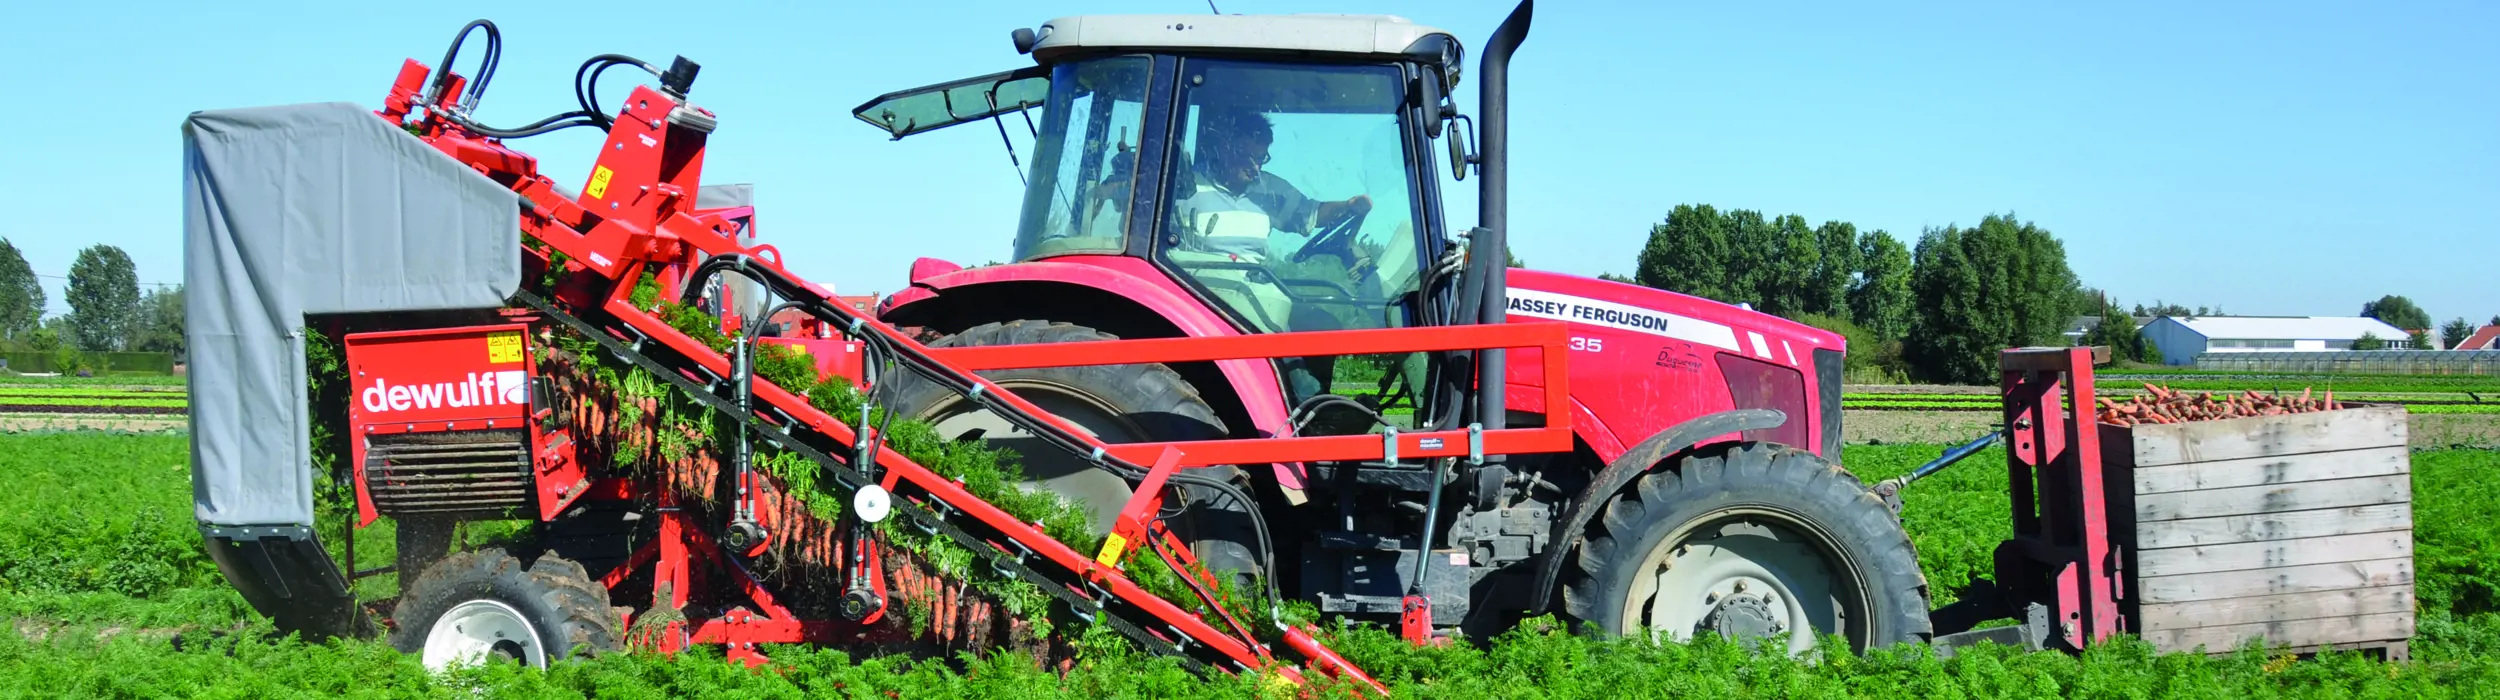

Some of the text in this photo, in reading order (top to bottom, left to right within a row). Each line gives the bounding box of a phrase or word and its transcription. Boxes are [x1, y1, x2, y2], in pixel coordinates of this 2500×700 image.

[1506, 297, 1668, 332] ASSEY FERGUSON
[362, 372, 495, 412] dewulf
